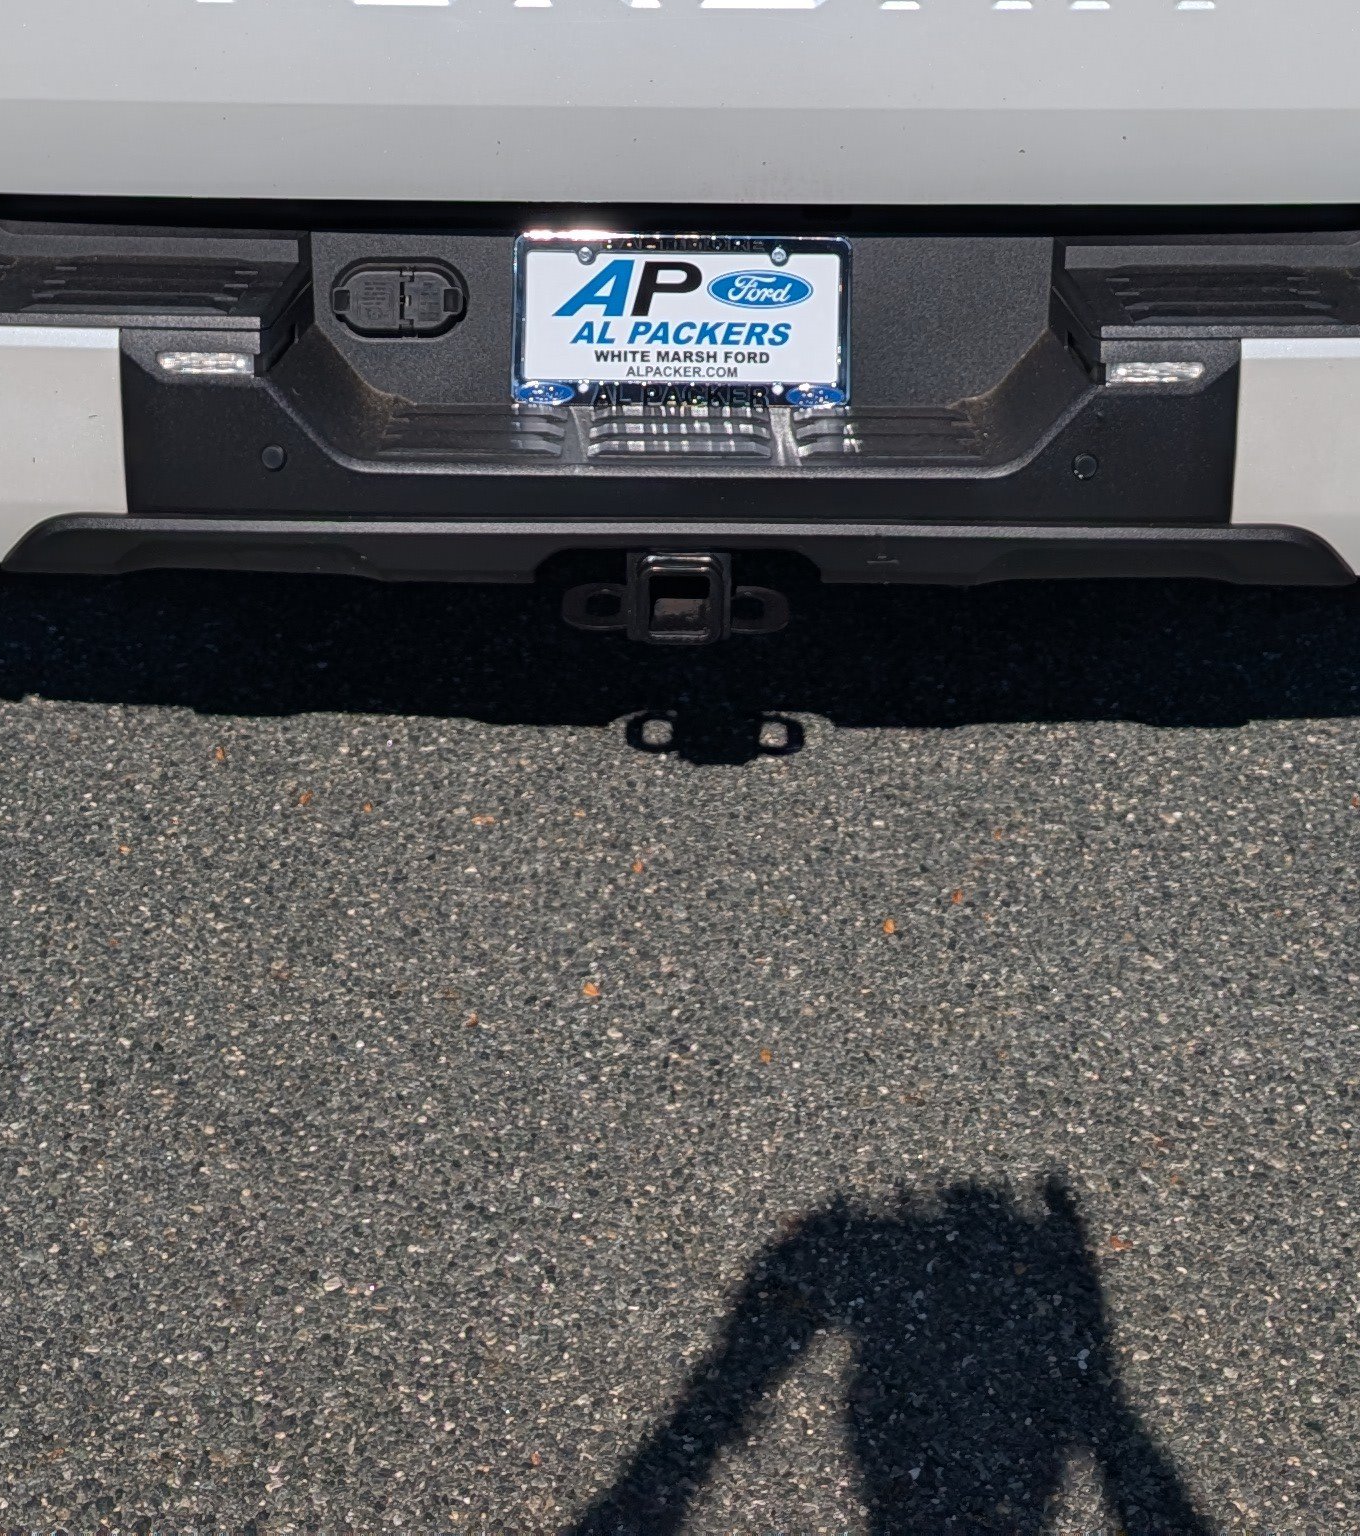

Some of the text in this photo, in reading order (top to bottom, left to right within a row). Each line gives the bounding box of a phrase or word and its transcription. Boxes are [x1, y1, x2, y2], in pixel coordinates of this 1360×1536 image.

[552, 259, 703, 317] AP
[729, 276, 793, 302] Ford
[570, 321, 792, 346] AL PACKERS
[595, 350, 770, 364] WHITE MARSH FORD
[625, 366, 738, 378] ALPACKER.COM
[591, 386, 632, 405] AL
[643, 385, 770, 406] PACKER
